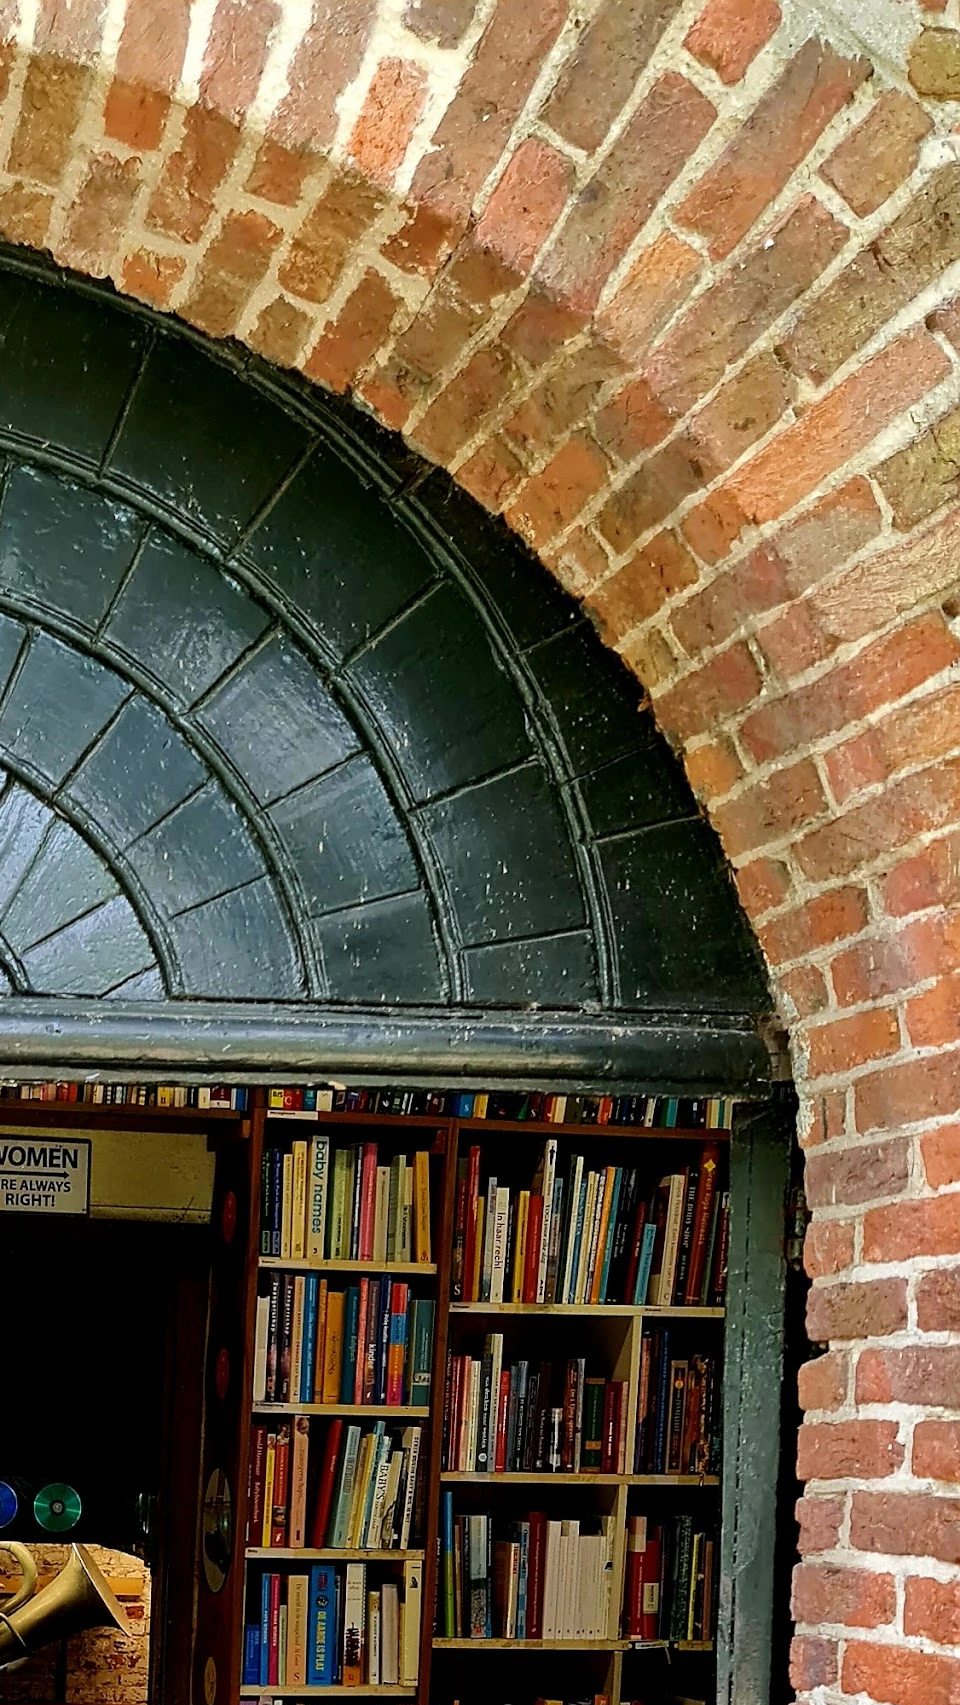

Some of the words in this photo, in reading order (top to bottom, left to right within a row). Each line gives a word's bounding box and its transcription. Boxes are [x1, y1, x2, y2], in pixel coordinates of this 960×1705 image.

[313, 1141, 327, 1179] baby
[20, 1179, 71, 1192] ALWAYS
[688, 1186, 696, 1200] THE
[5, 1193, 55, 1207] RIGHT!
[312, 1184, 324, 1234] names
[702, 1192, 712, 1210] Yoga
[498, 1212, 505, 1220] In
[685, 1203, 694, 1224] BODY
[495, 1223, 504, 1243] haar
[682, 1227, 690, 1248] SHOP
[698, 1212, 709, 1245] Retreats
[494, 1245, 503, 1269] recht
[376, 1464, 389, 1500] BABY'S
[316, 1622, 326, 1644] AARDE
[316, 1645, 325, 1653] IS
[315, 1654, 325, 1671] PLAT
